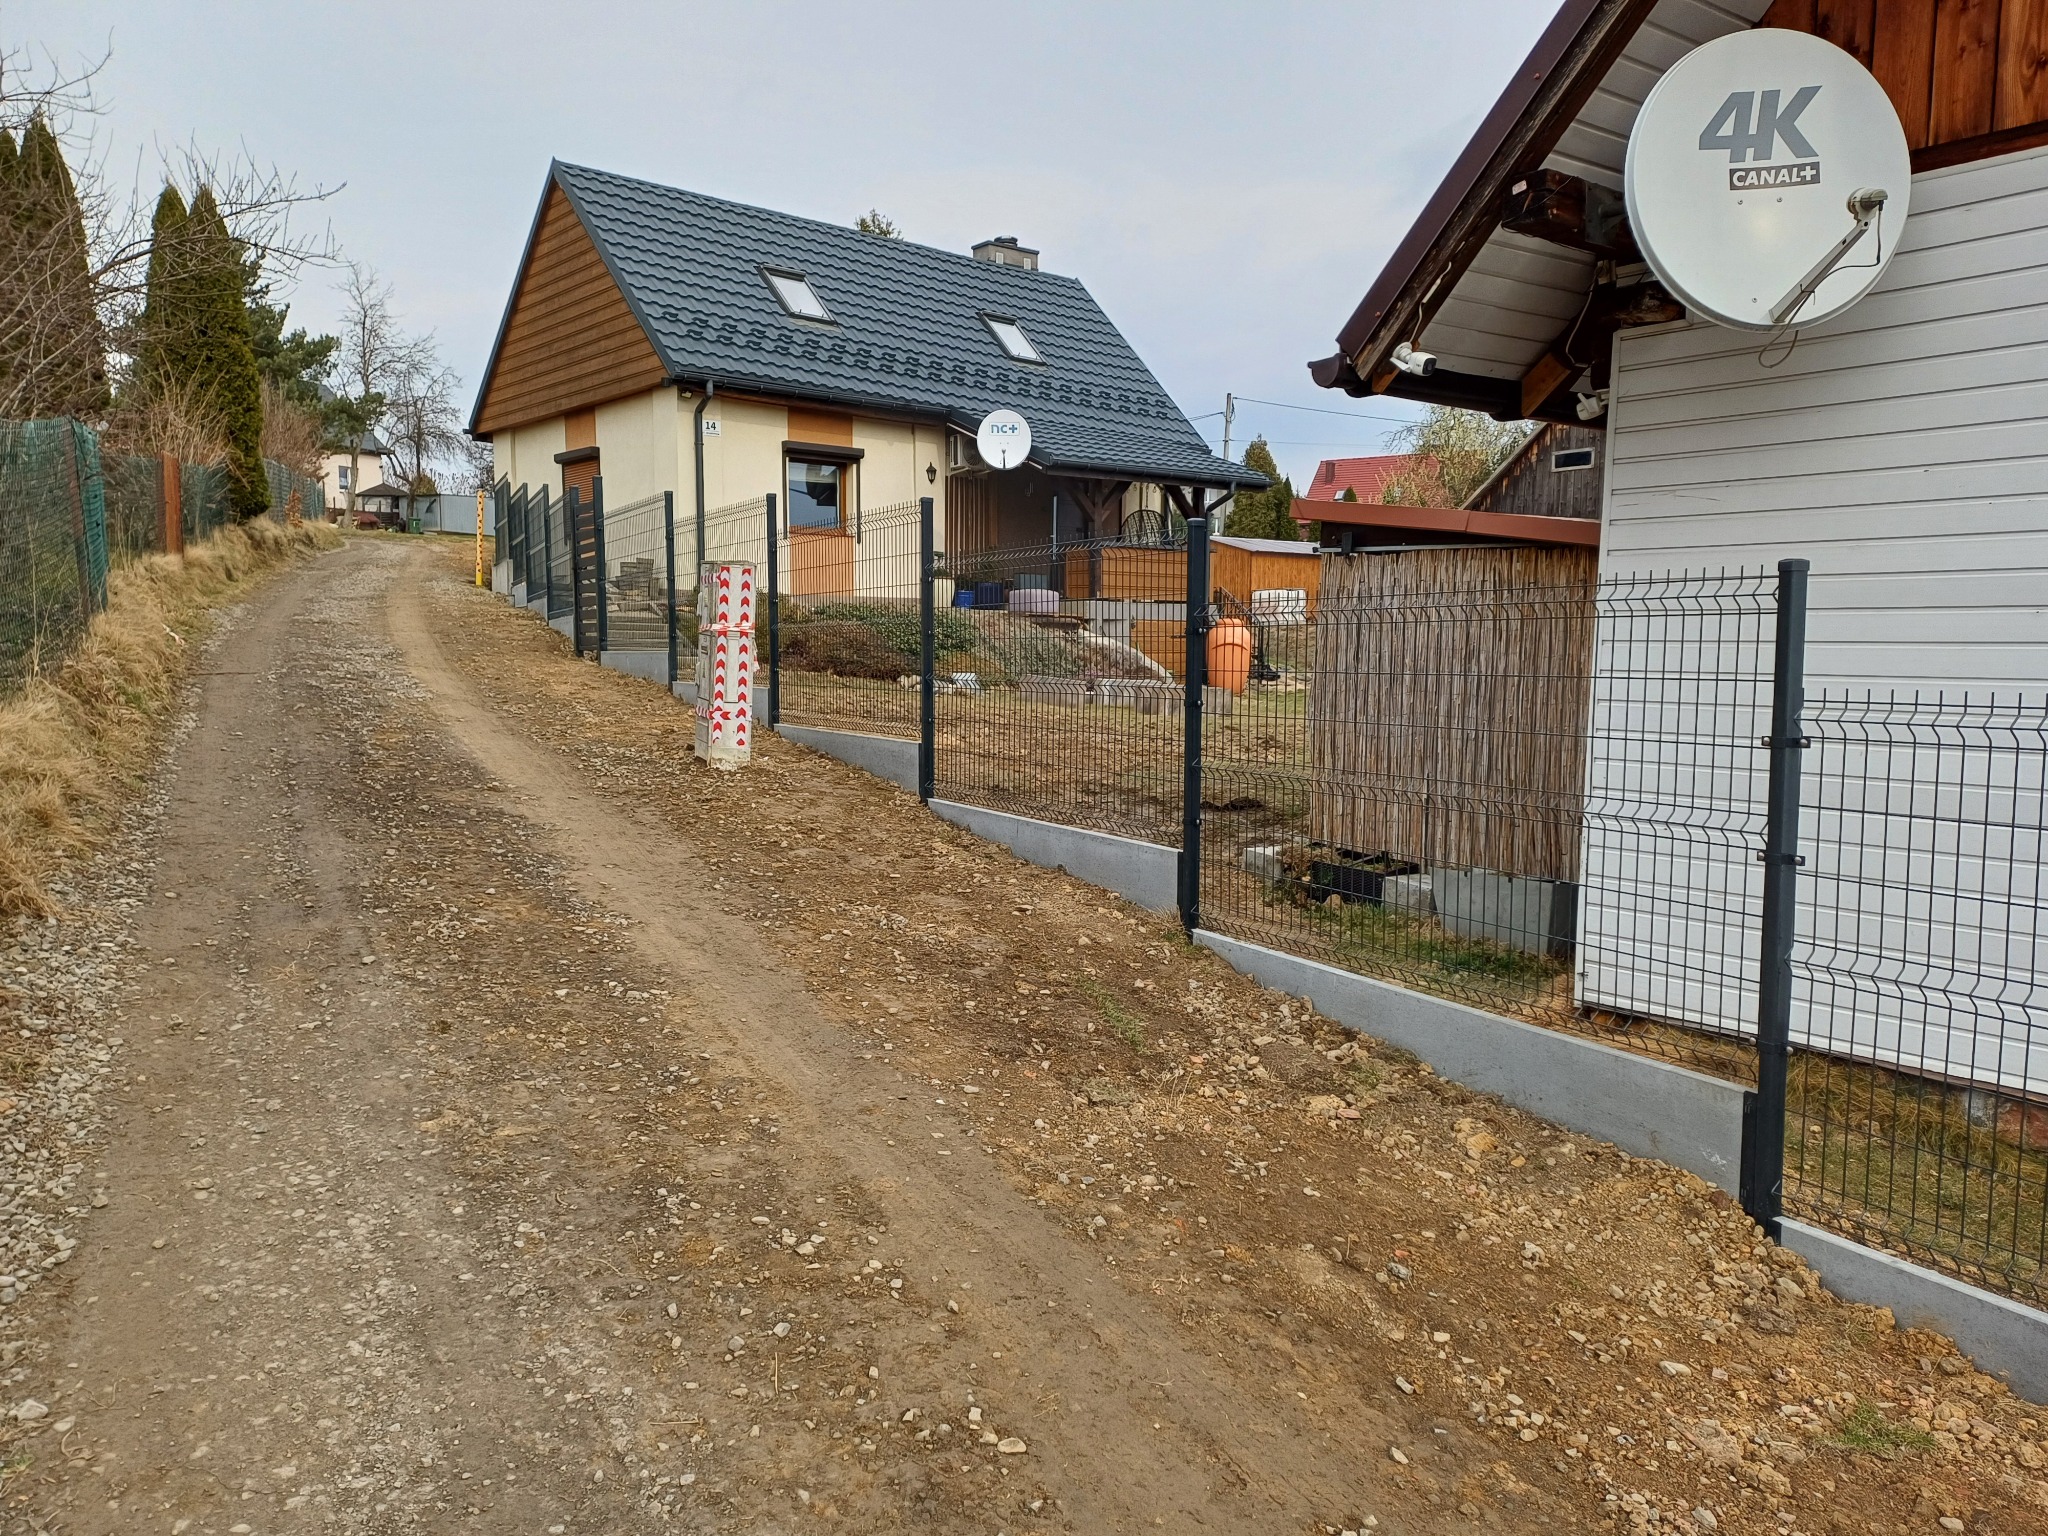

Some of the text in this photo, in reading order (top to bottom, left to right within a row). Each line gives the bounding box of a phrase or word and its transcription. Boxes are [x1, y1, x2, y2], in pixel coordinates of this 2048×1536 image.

[1699, 85, 1823, 163] 4K
[1731, 165, 1817, 187] CANAL+
[705, 421, 717, 431] 14
[990, 424, 1018, 434] nc+
